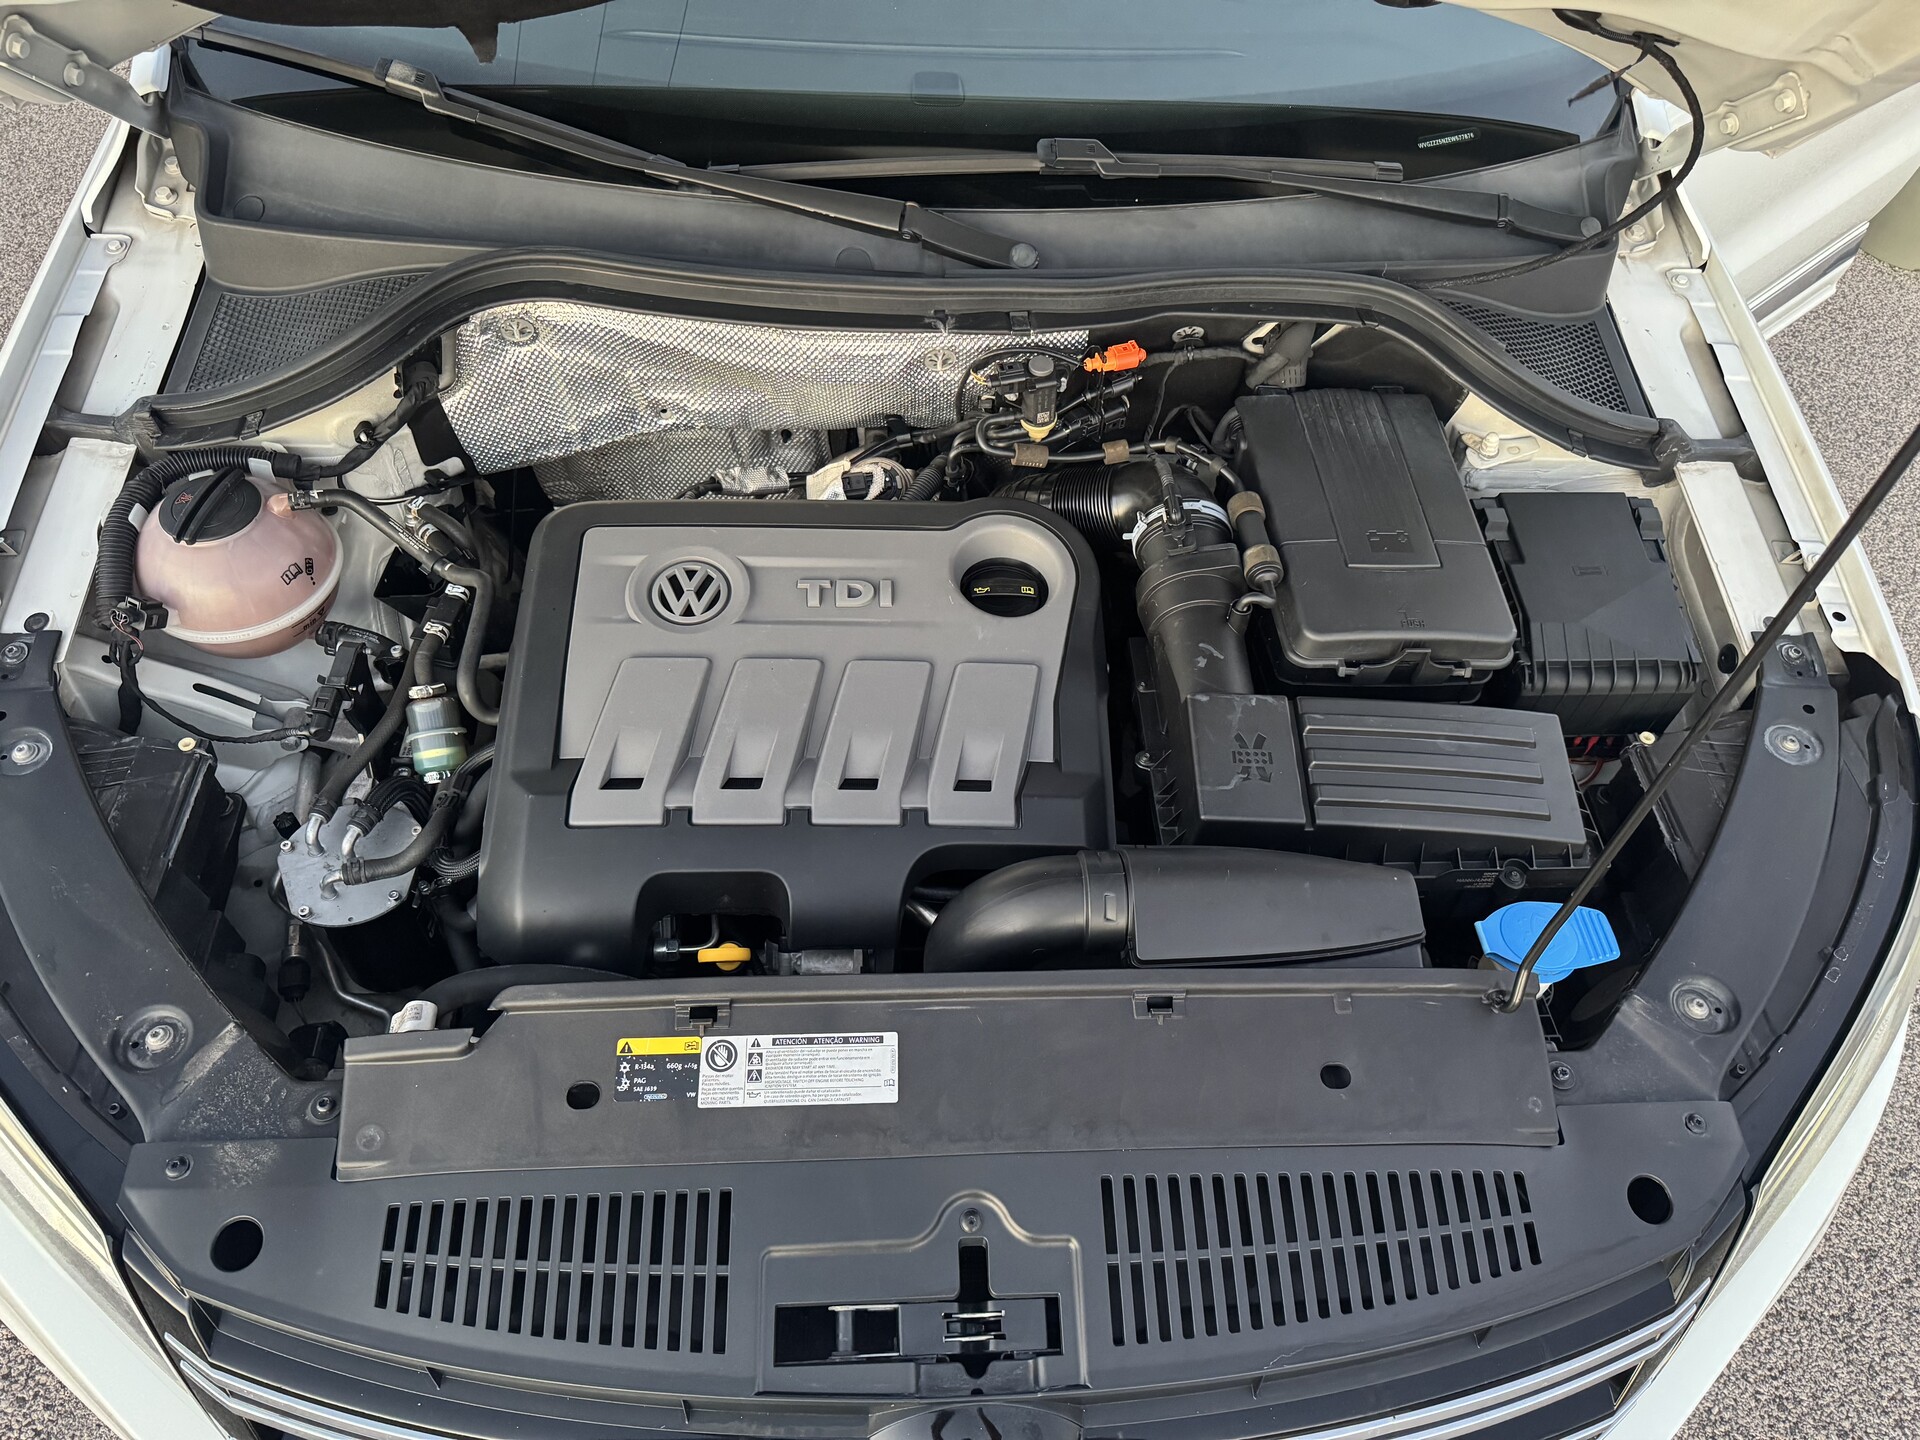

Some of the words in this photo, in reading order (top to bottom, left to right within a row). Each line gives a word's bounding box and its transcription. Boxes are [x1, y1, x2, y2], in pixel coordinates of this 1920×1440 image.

[796, 579, 893, 608] TDI
[304, 618, 316, 630] min
[1400, 620, 1424, 628] PUSH
[775, 1037, 808, 1045] ATENCIÓN
[814, 1036, 843, 1044] ATENÇÃO
